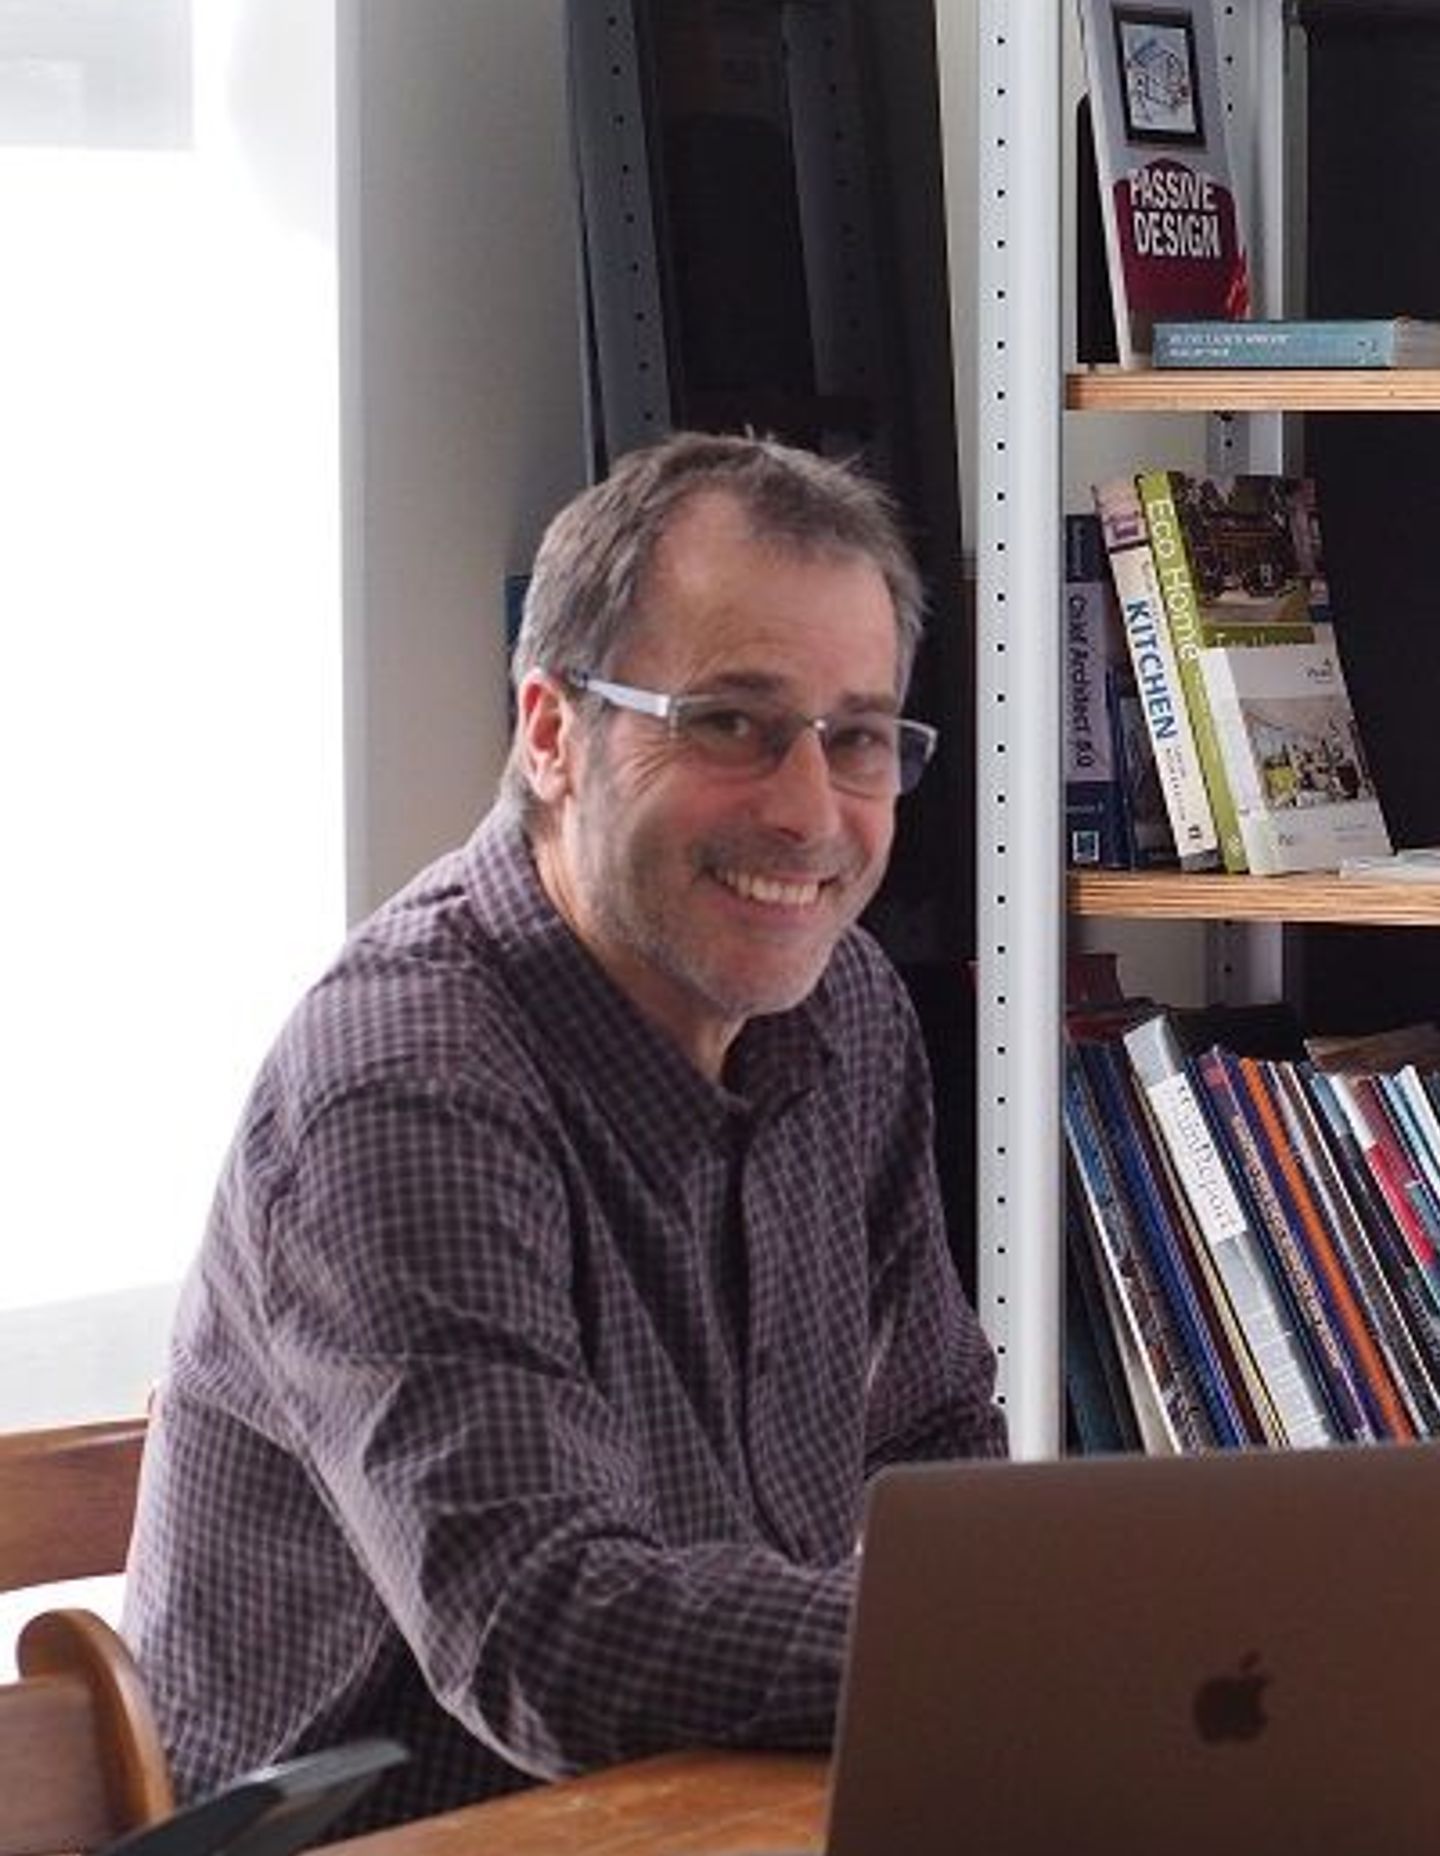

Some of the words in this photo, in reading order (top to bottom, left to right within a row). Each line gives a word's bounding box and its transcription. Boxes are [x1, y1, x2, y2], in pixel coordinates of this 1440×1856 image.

[1129, 168, 1217, 210] PASSIVE
[1134, 210, 1221, 258] DESIGN
[1146, 499, 1176, 559] Eco
[1164, 565, 1201, 660] Home
[1070, 648, 1092, 732] Architect
[1126, 599, 1178, 740] KITCHEN
